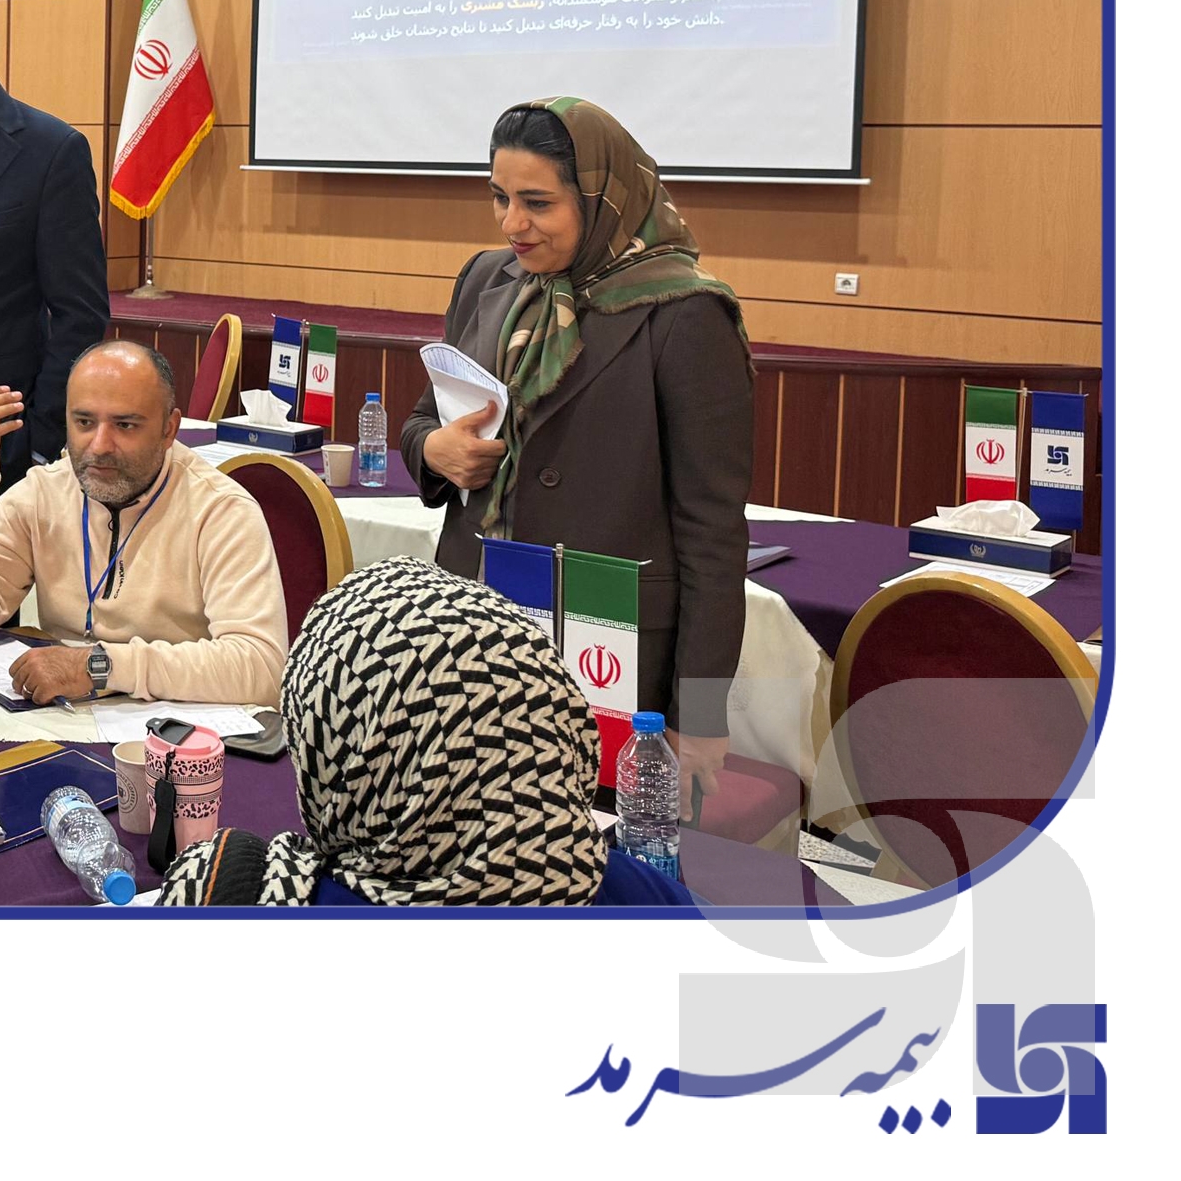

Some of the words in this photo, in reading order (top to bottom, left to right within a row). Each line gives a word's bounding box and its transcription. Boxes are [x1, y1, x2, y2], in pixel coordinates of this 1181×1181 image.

[351, 7, 373, 20] کنید
[435, 3, 446, 14] به
[449, 0, 458, 14] را
[490, 20, 514, 33] کنید
[516, 18, 545, 34] تبدیل
[595, 14, 622, 31] رفتار
[626, 15, 639, 28] به
[643, 11, 652, 28] را
[657, 15, 681, 29] خود
[380, 26, 402, 42] خلق
[405, 24, 448, 38] درخشان
[479, 21, 487, 33] تا
[351, 29, 378, 42] شوند
